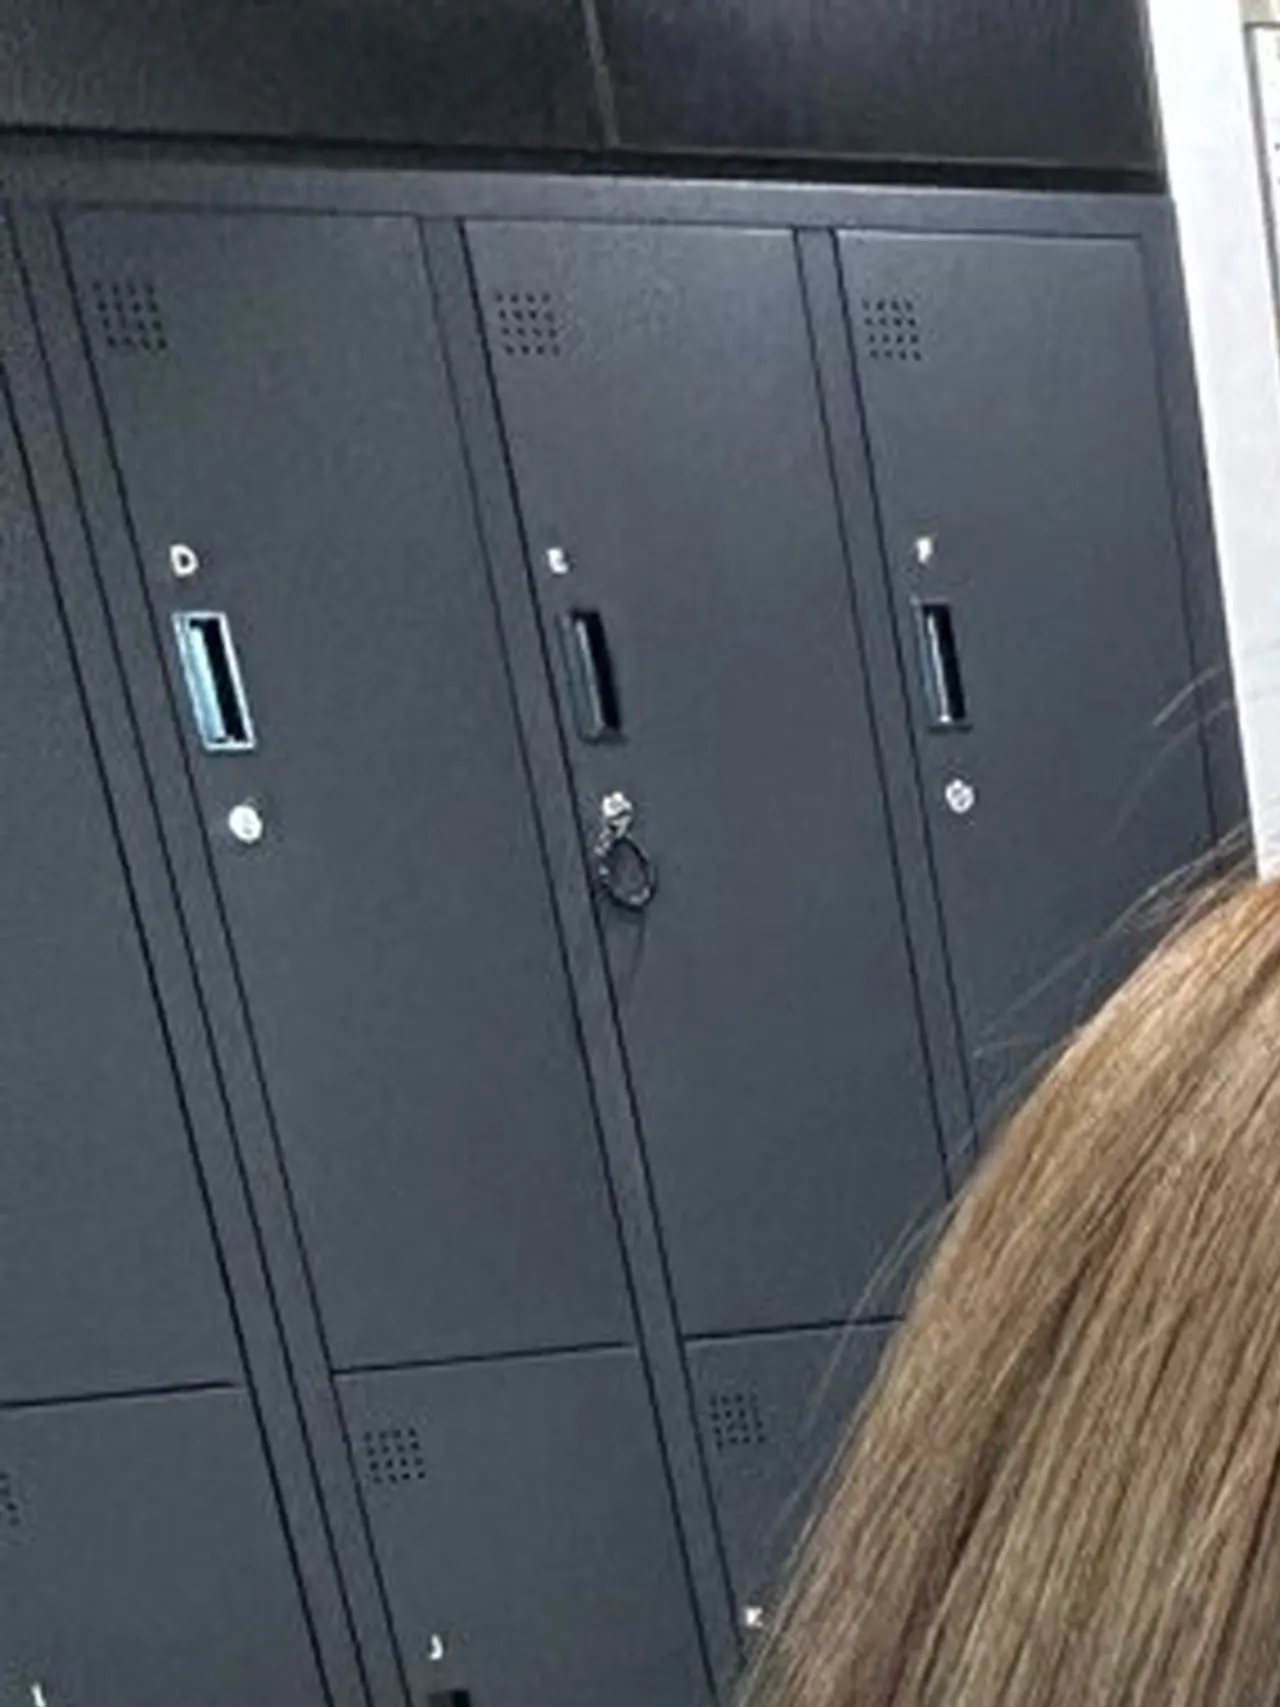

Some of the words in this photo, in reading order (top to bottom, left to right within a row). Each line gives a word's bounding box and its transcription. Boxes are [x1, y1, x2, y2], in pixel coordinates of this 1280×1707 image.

[169, 543, 200, 578] D
[546, 547, 569, 574] E
[916, 536, 934, 564] F
[429, 1632, 444, 1661] J
